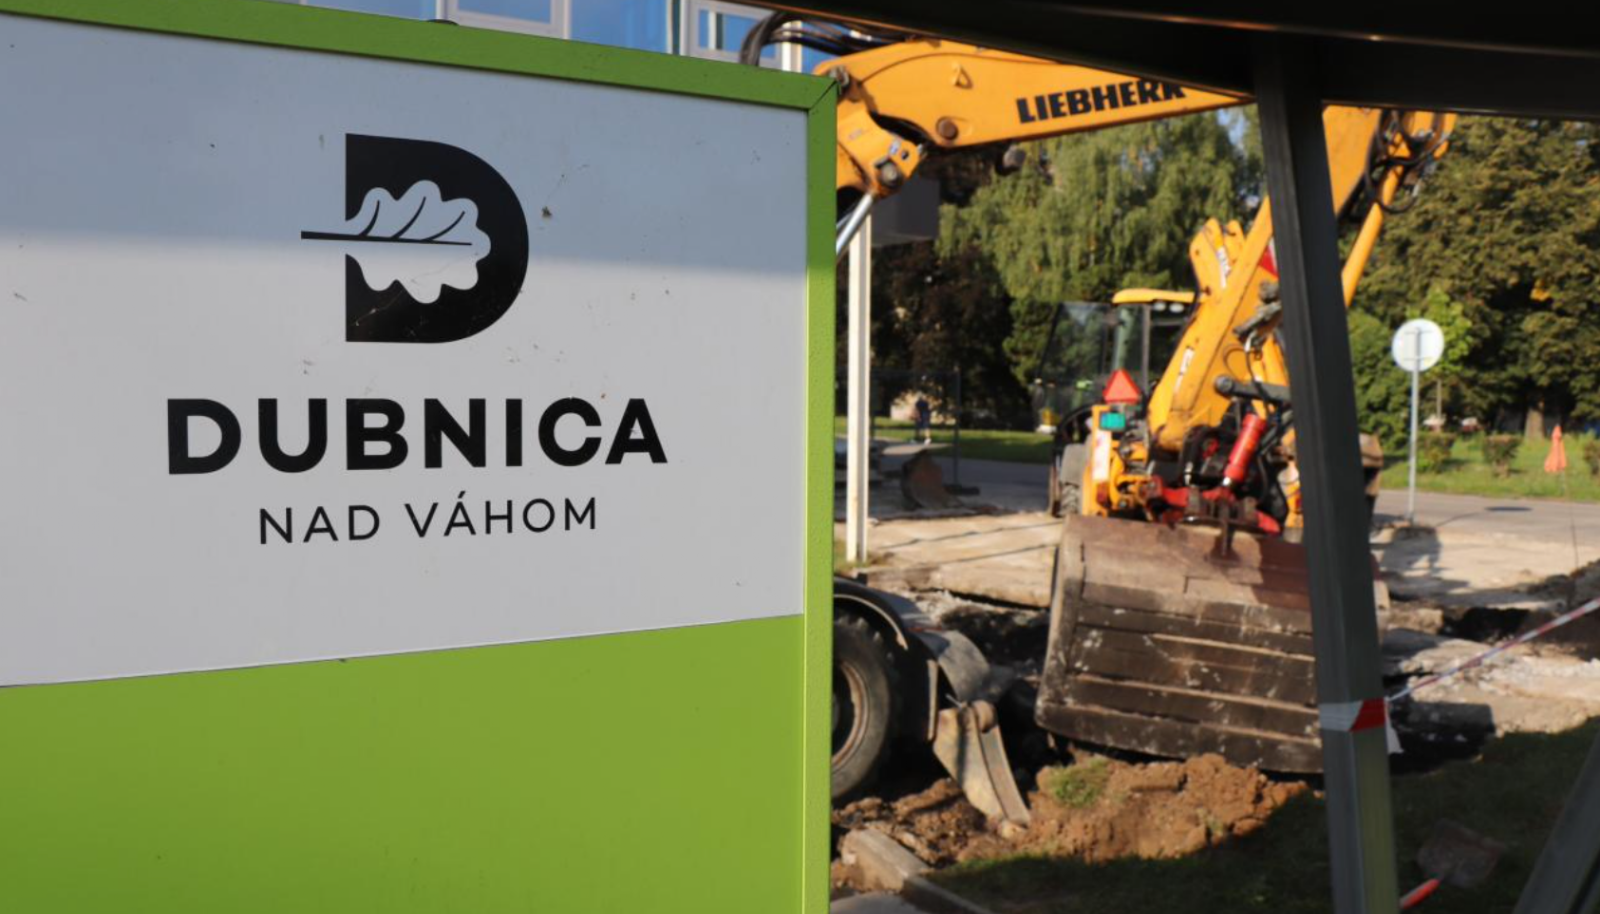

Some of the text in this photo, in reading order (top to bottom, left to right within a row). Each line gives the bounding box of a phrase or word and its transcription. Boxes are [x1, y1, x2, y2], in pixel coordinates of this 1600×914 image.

[167, 397, 668, 475] DUBNICA
[259, 490, 598, 545] NAD VÁHOM
